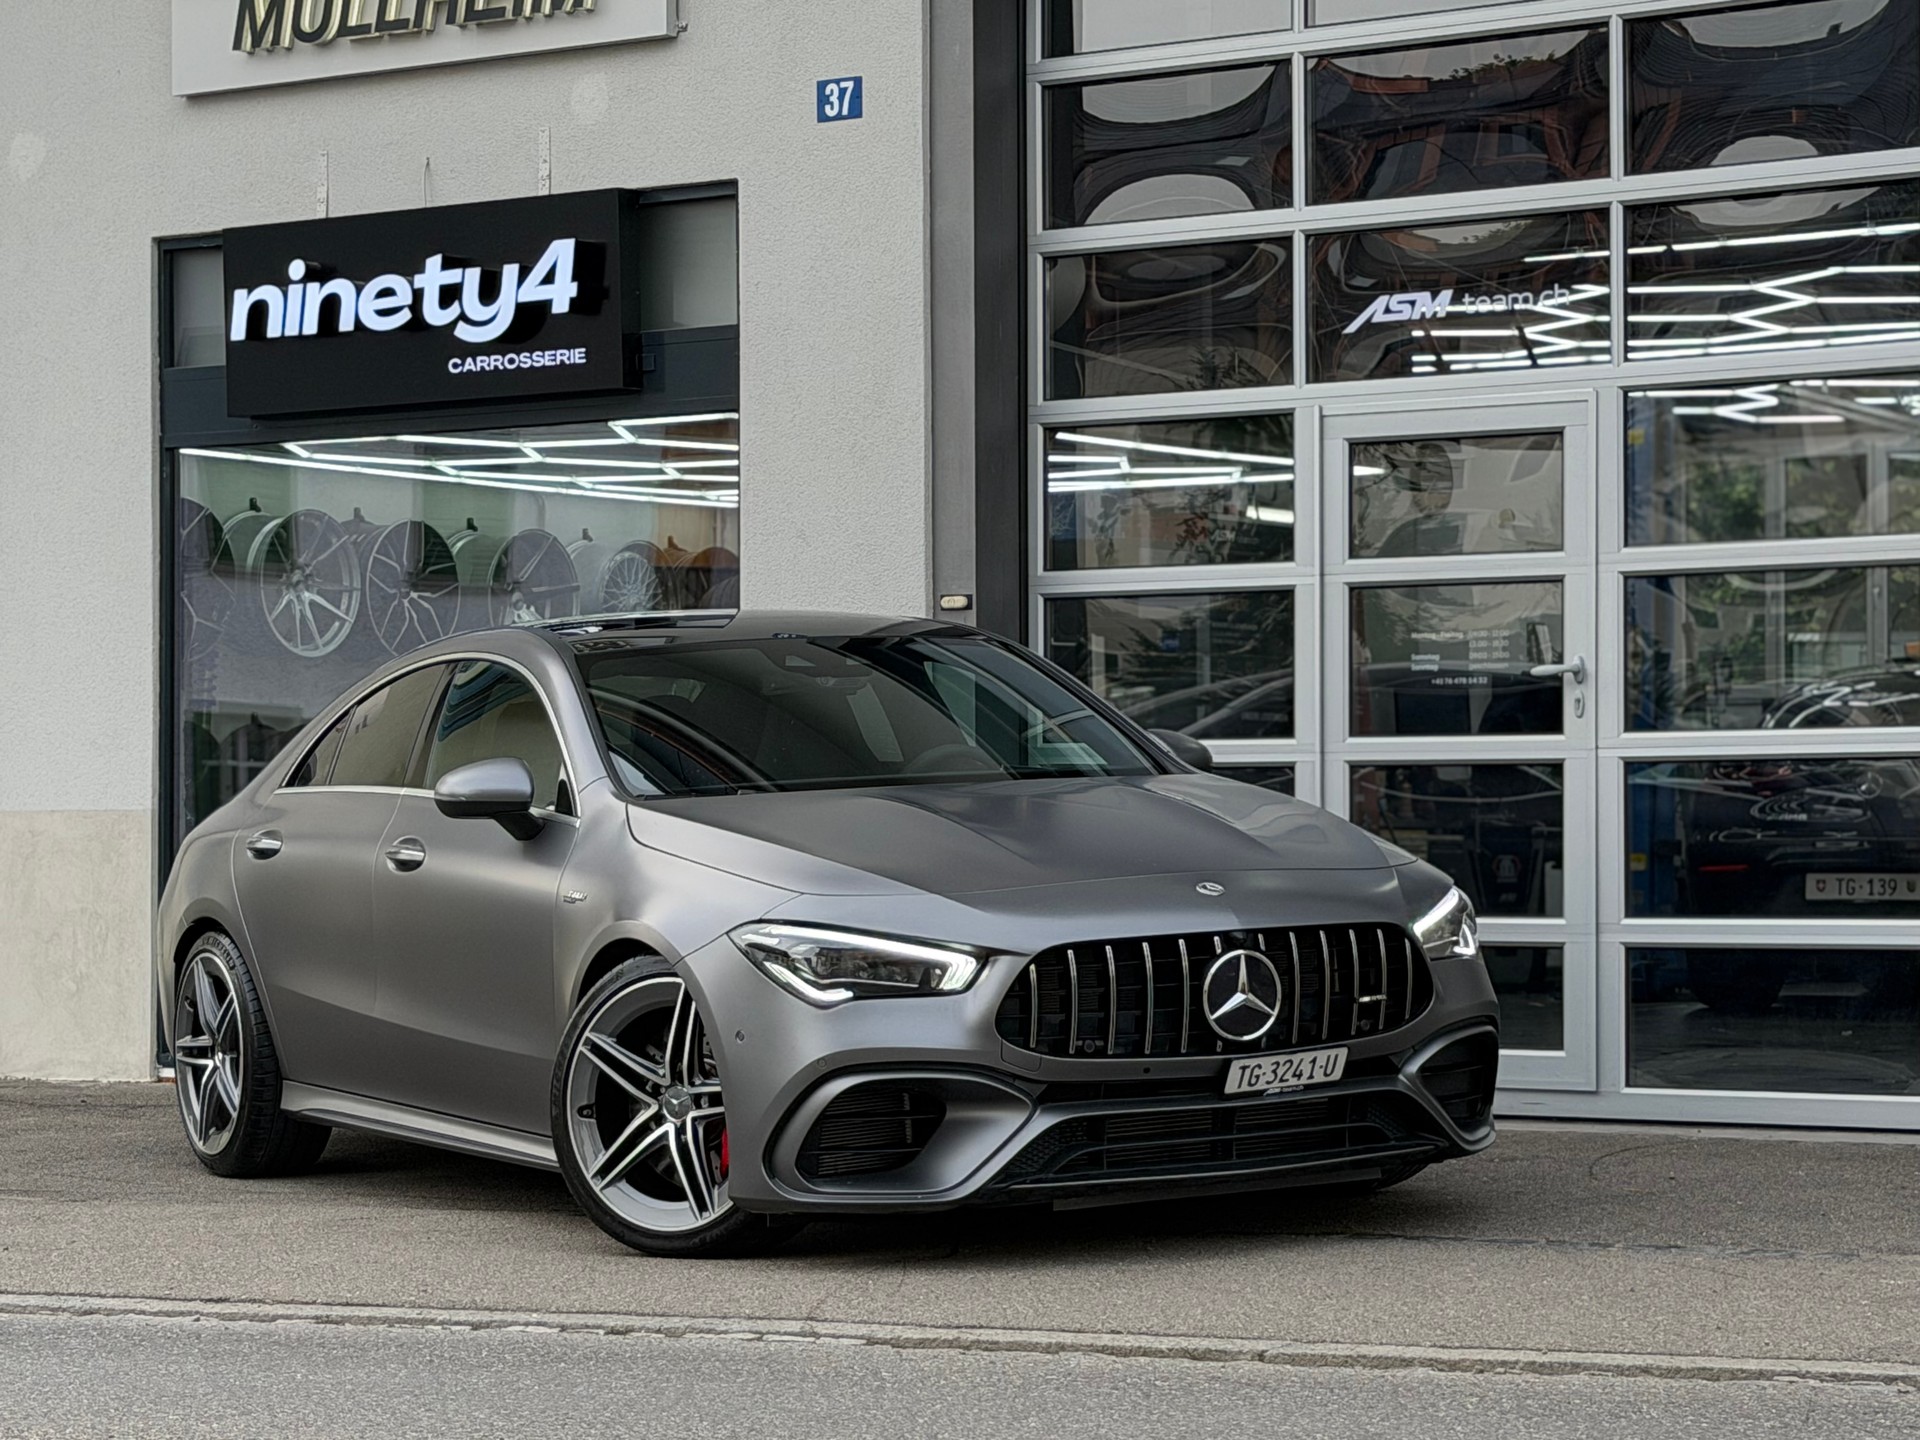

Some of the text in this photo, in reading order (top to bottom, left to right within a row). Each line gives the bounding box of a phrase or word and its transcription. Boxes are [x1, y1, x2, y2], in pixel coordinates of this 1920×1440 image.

[825, 81, 854, 117] 37
[230, 238, 578, 343] ninety4
[1341, 283, 1569, 334] ASM team.ch
[448, 348, 587, 374] CARROSSERIE
